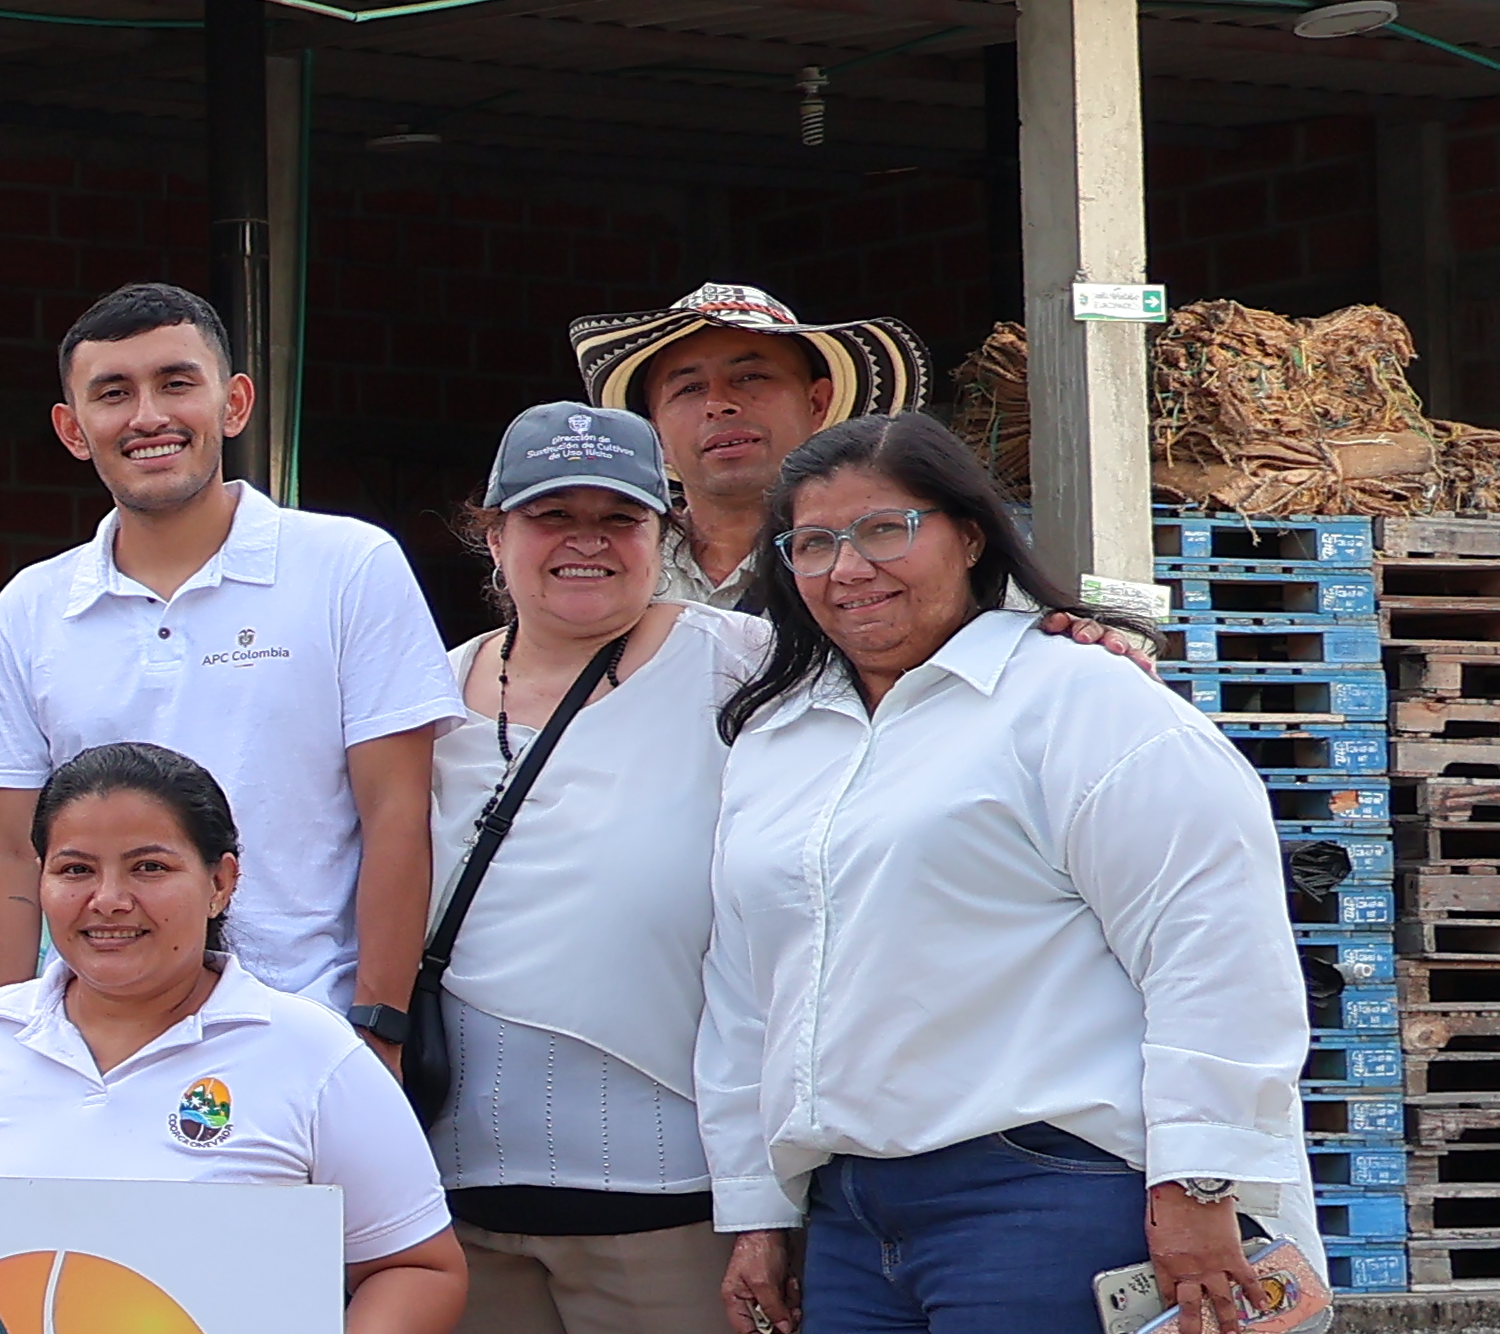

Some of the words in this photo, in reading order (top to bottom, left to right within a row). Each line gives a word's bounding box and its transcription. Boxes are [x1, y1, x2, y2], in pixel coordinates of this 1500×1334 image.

[598, 435, 611, 443] de
[597, 443, 635, 456] Cultivos
[202, 653, 229, 666] APC
[232, 647, 289, 661] Colombia
